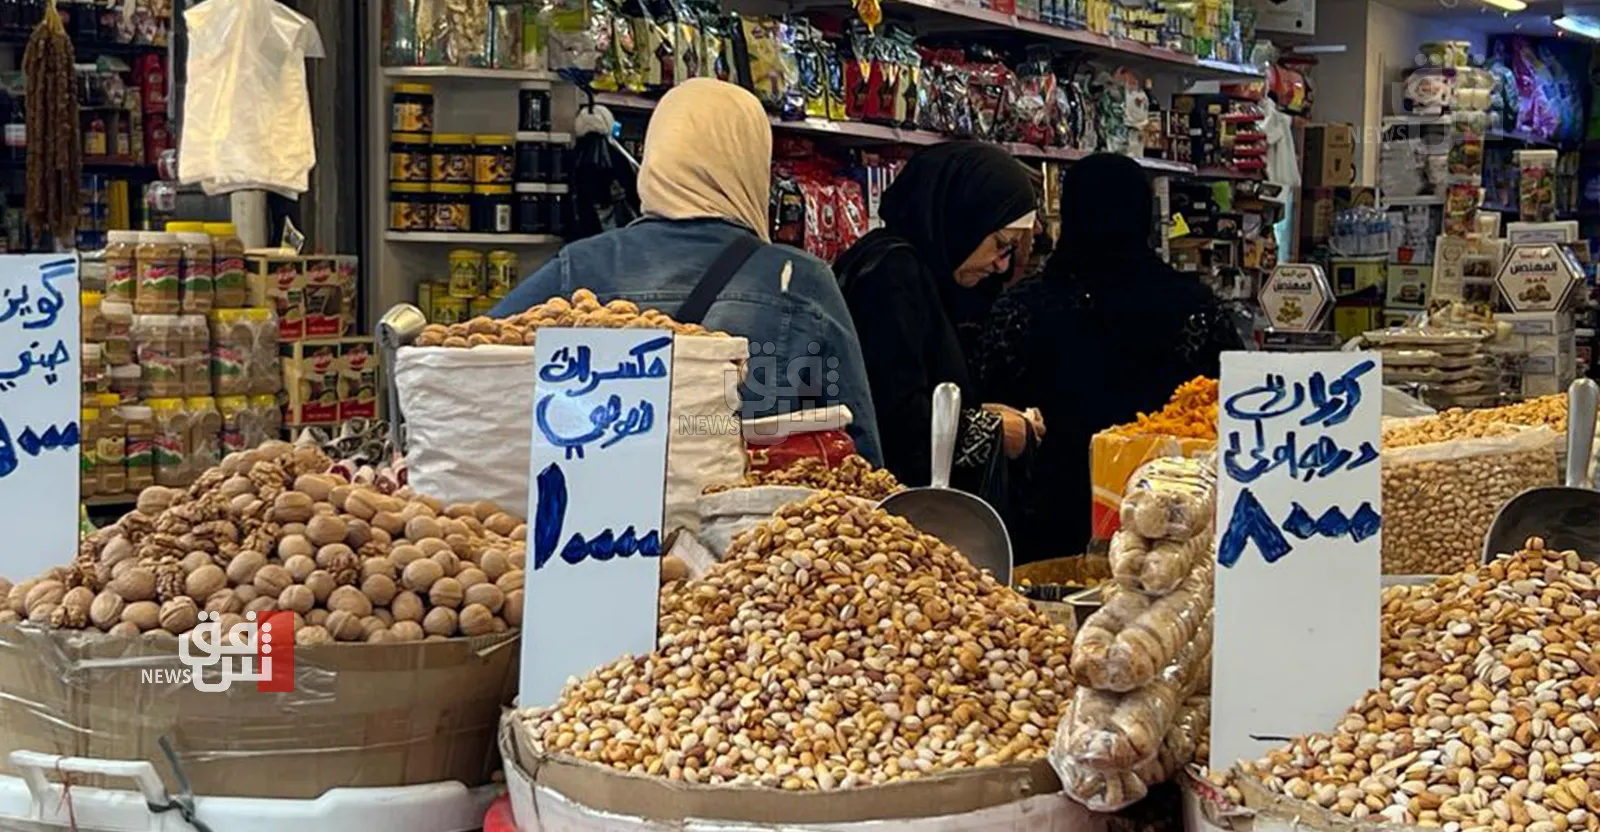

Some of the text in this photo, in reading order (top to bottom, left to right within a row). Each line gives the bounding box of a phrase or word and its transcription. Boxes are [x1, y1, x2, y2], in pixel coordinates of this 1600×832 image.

[539, 336, 674, 397] مكسرات
[534, 462, 664, 571] ١٠٠٠٠
[1217, 487, 1382, 569] ٨٠٠٠
